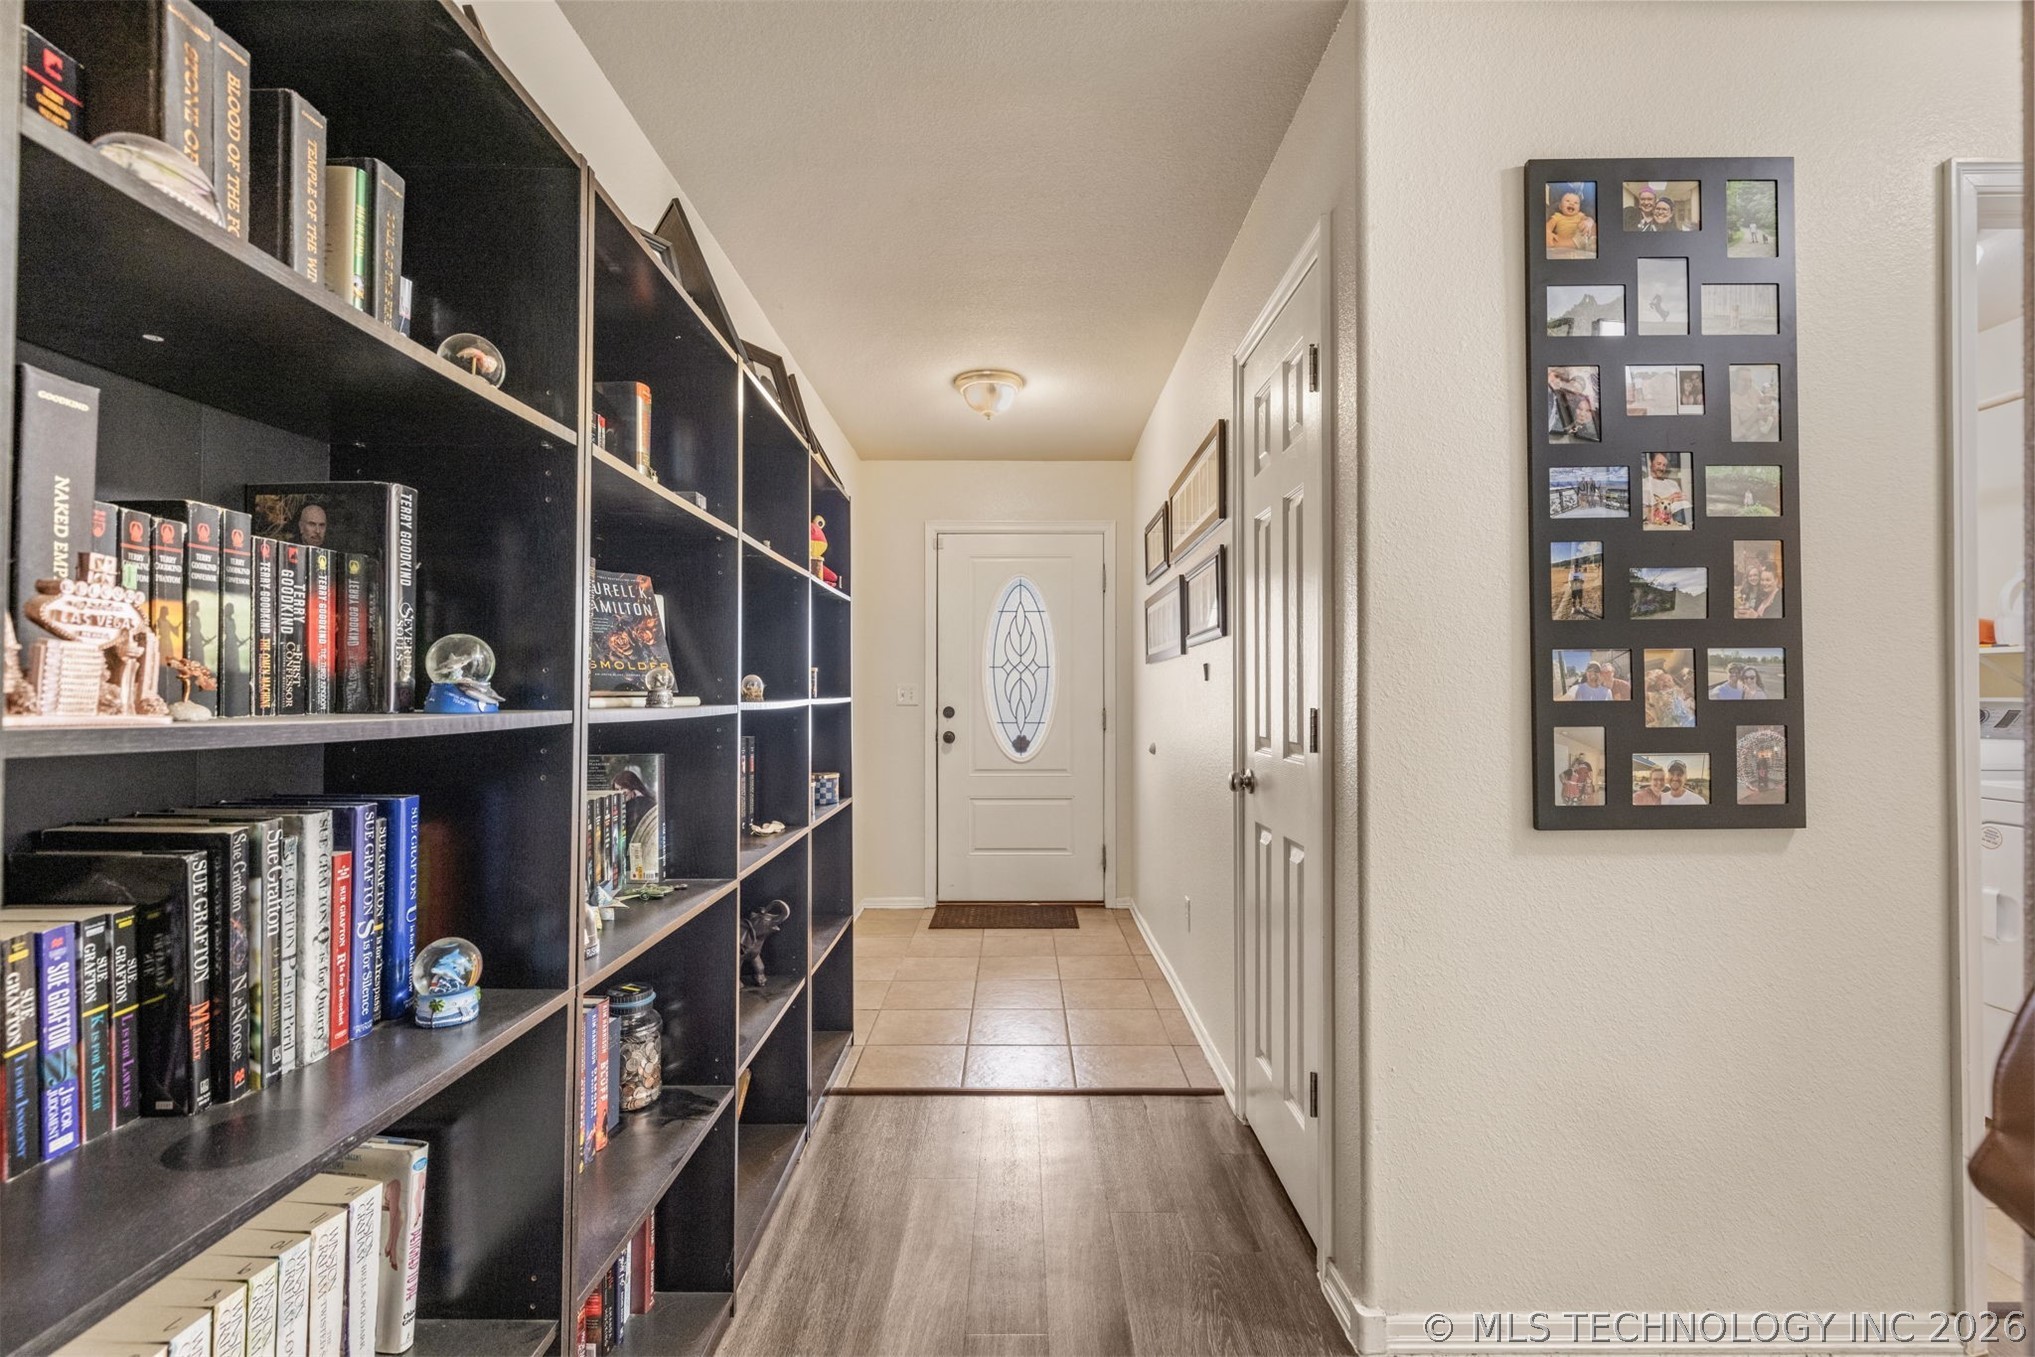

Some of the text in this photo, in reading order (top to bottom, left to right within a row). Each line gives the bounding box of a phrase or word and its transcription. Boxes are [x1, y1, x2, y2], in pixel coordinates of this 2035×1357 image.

[183, 42, 200, 127] STONE
[226, 71, 241, 210] BLOOD OF THE
[306, 139, 318, 256] TEMPLE OF THE
[53, 475, 71, 581] NAKED EMP
[400, 493, 413, 587] TERRY GOODKIND
[259, 562, 271, 589] TERRY
[317, 575, 328, 600] TERRY
[594, 581, 635, 598] URELL
[60, 610, 92, 624] LAS
[259, 591, 271, 634] GOODKIND
[280, 569, 294, 634] GOODKIND
[293, 583, 306, 624] TERRY
[593, 599, 653, 617] AMILTON
[317, 603, 328, 644] GOODKIND
[285, 642, 296, 707] CONFESSOR
[292, 651, 303, 687] FIRST
[231, 832, 247, 860] Sue
[363, 811, 375, 841] SUE
[377, 826, 387, 844] SUE
[266, 829, 283, 865] Sue
[192, 860, 209, 896] SUE
[231, 861, 247, 913] Grafton
[338, 885, 347, 901] SUE
[363, 843, 375, 916] GRAFTON
[376, 846, 387, 917] GRAFTON
[266, 866, 284, 938] Grafton
[284, 877, 295, 950] GRAFTON
[405, 904, 417, 922] U
[192, 898, 210, 984] GRAFTON
[312, 818, 330, 1041] SUE GRAFTON Q is for Quarry
[338, 903, 347, 947] GRAFTON
[356, 920, 375, 939] S
[362, 939, 373, 950] is
[83, 943, 98, 1004] GRAFTON
[96, 956, 109, 983] SUE
[114, 945, 128, 1004] GRAFTON
[126, 957, 138, 983] SUE
[282, 953, 297, 972] P
[336, 952, 347, 966] R
[362, 952, 373, 969] for
[231, 972, 248, 994] N
[283, 976, 295, 988] is
[283, 991, 295, 1012] for
[361, 971, 373, 1015] Silence
[6, 972, 22, 1048] GRAFTON
[20, 988, 35, 1021] SUE
[46, 961, 71, 1050] SUE GRAFTON
[90, 1014, 104, 1027] K
[121, 1013, 134, 1026] L
[189, 1000, 210, 1030] M
[192, 1026, 203, 1062] MALICE
[283, 1016, 295, 1052] Peril
[60, 1094, 73, 1106] IS
[91, 1064, 106, 1111] KILLER
[46, 1088, 60, 1140] JUDGMENT
[60, 1106, 73, 1131] FOR
[354, 1203, 365, 1264] GRAHAM
[363, 1196, 375, 1260] WINSTON
[316, 1233, 329, 1300] GRAHAM
[325, 1226, 339, 1293] WINSTON
[281, 1257, 296, 1328] GRAHAM
[292, 1249, 307, 1319] WINSTON
[248, 1284, 263, 1357] GRAHAM
[262, 1275, 275, 1350] WINSTON
[359, 1299, 367, 1350] POLDARK
